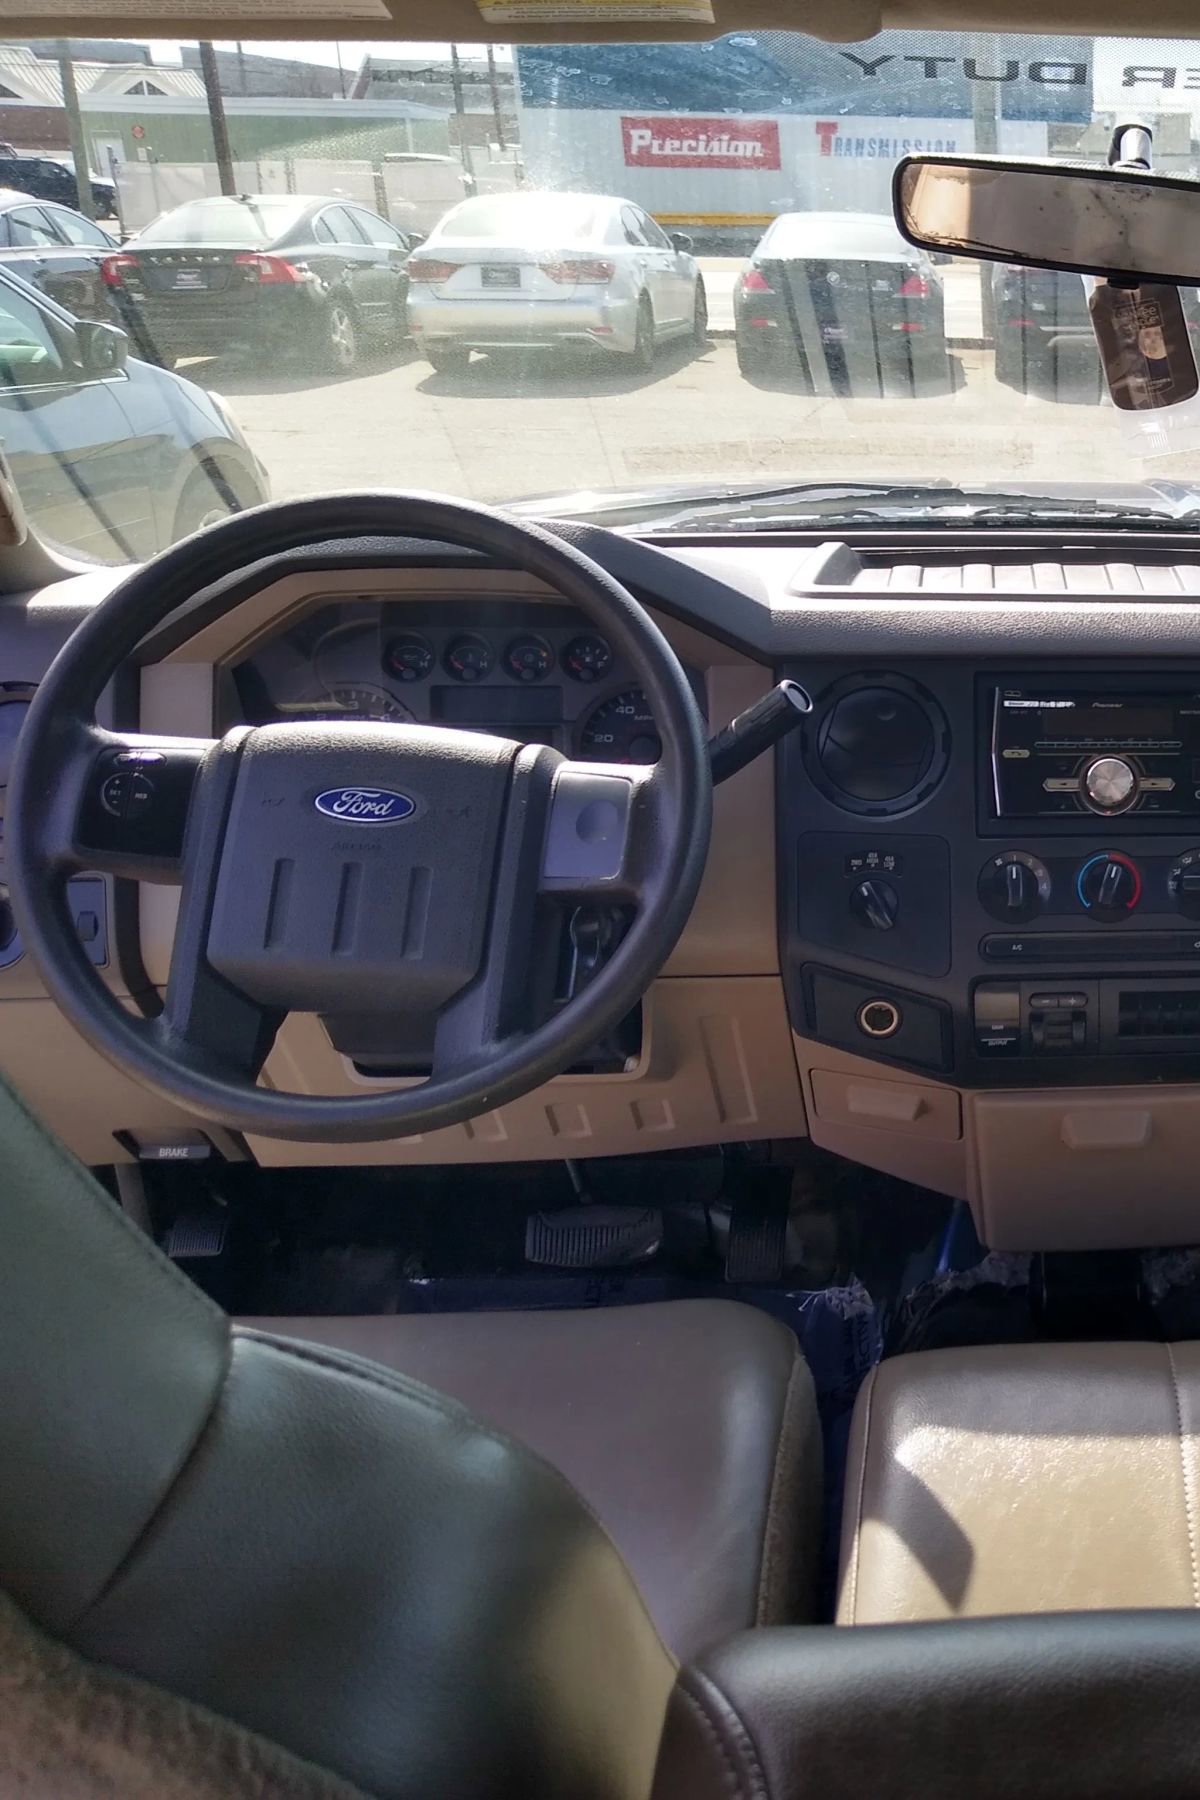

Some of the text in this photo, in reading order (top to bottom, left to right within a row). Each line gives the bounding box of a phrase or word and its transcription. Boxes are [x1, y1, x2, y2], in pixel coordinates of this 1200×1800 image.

[630, 128, 765, 158] Precision
[616, 706, 635, 714] 40
[594, 734, 614, 742] 20
[332, 790, 394, 816] Ford
[159, 1147, 189, 1157] BRAKE
